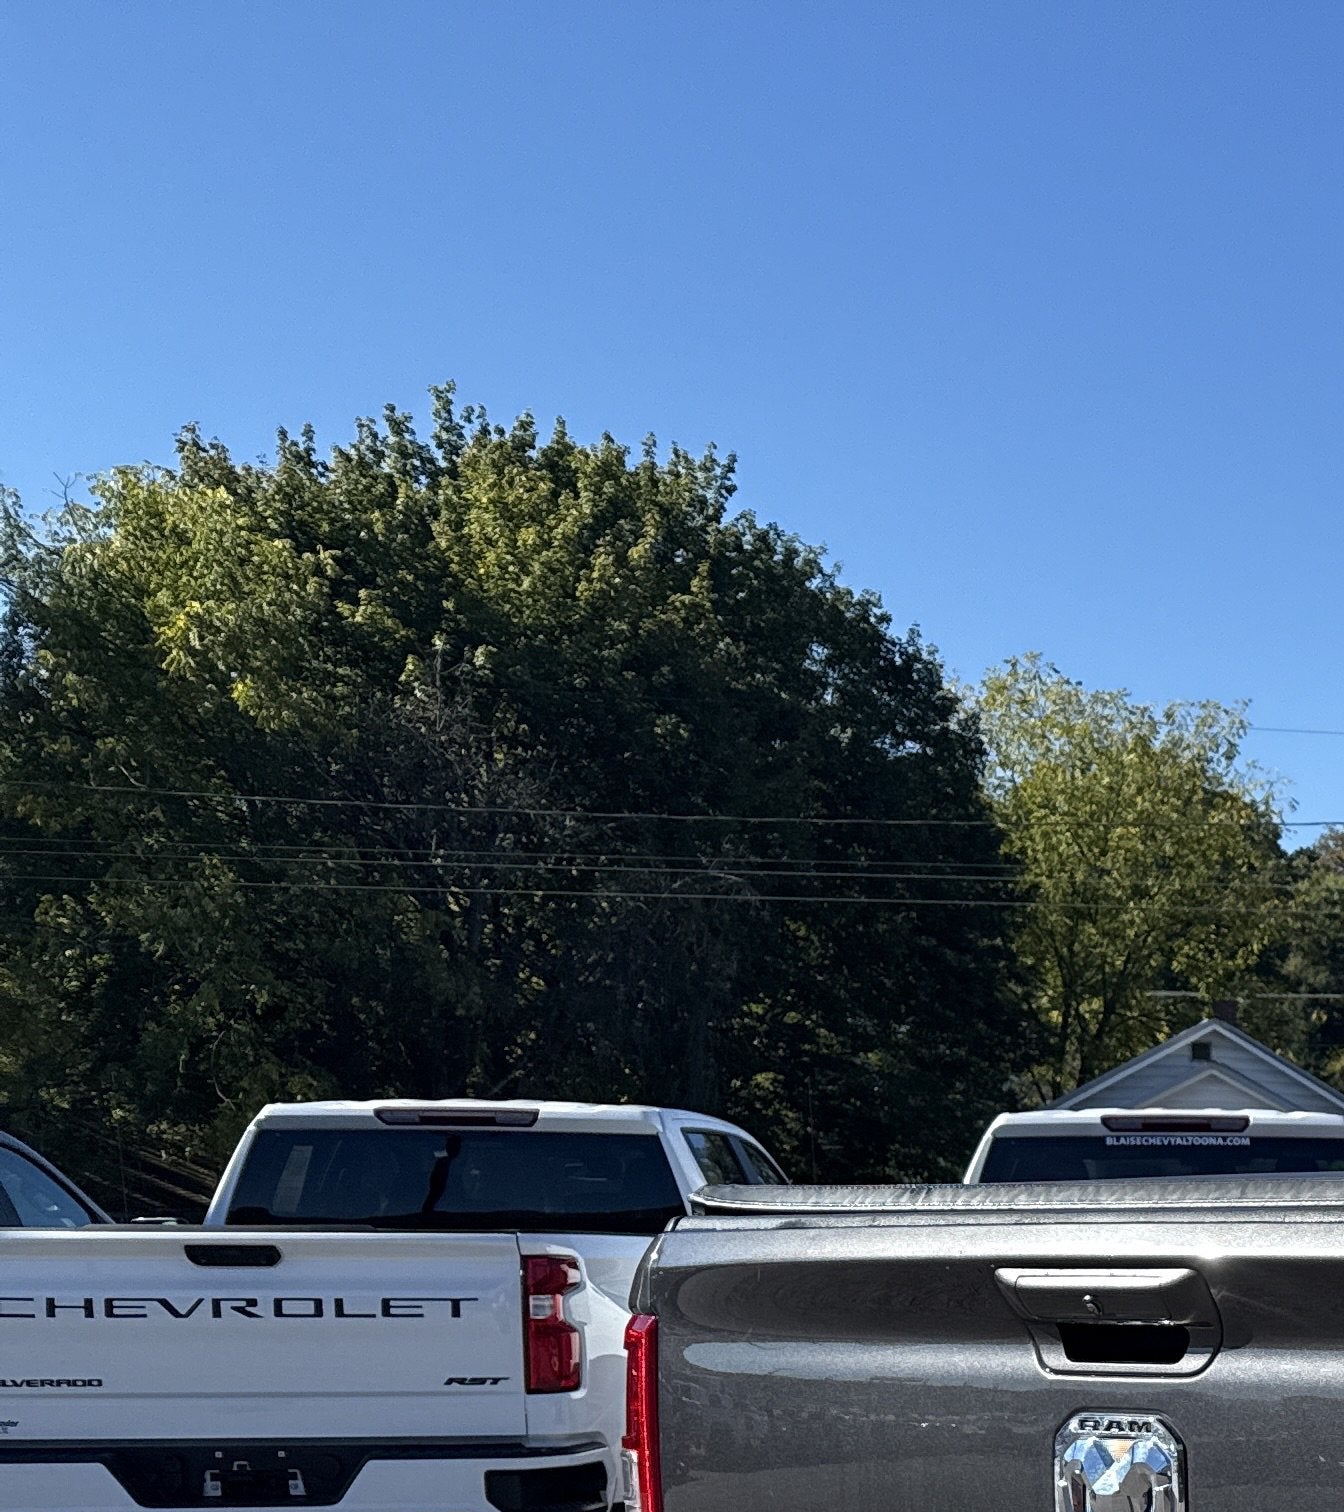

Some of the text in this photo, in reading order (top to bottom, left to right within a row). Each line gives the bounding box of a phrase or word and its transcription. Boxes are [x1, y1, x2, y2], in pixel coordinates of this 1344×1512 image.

[1105, 1136, 1251, 1146] BLAISECHEVYALTOONA.COM
[0, 1297, 480, 1319] CHEVROLET
[443, 1376, 510, 1386] RST
[1079, 1419, 1152, 1433] RAM
